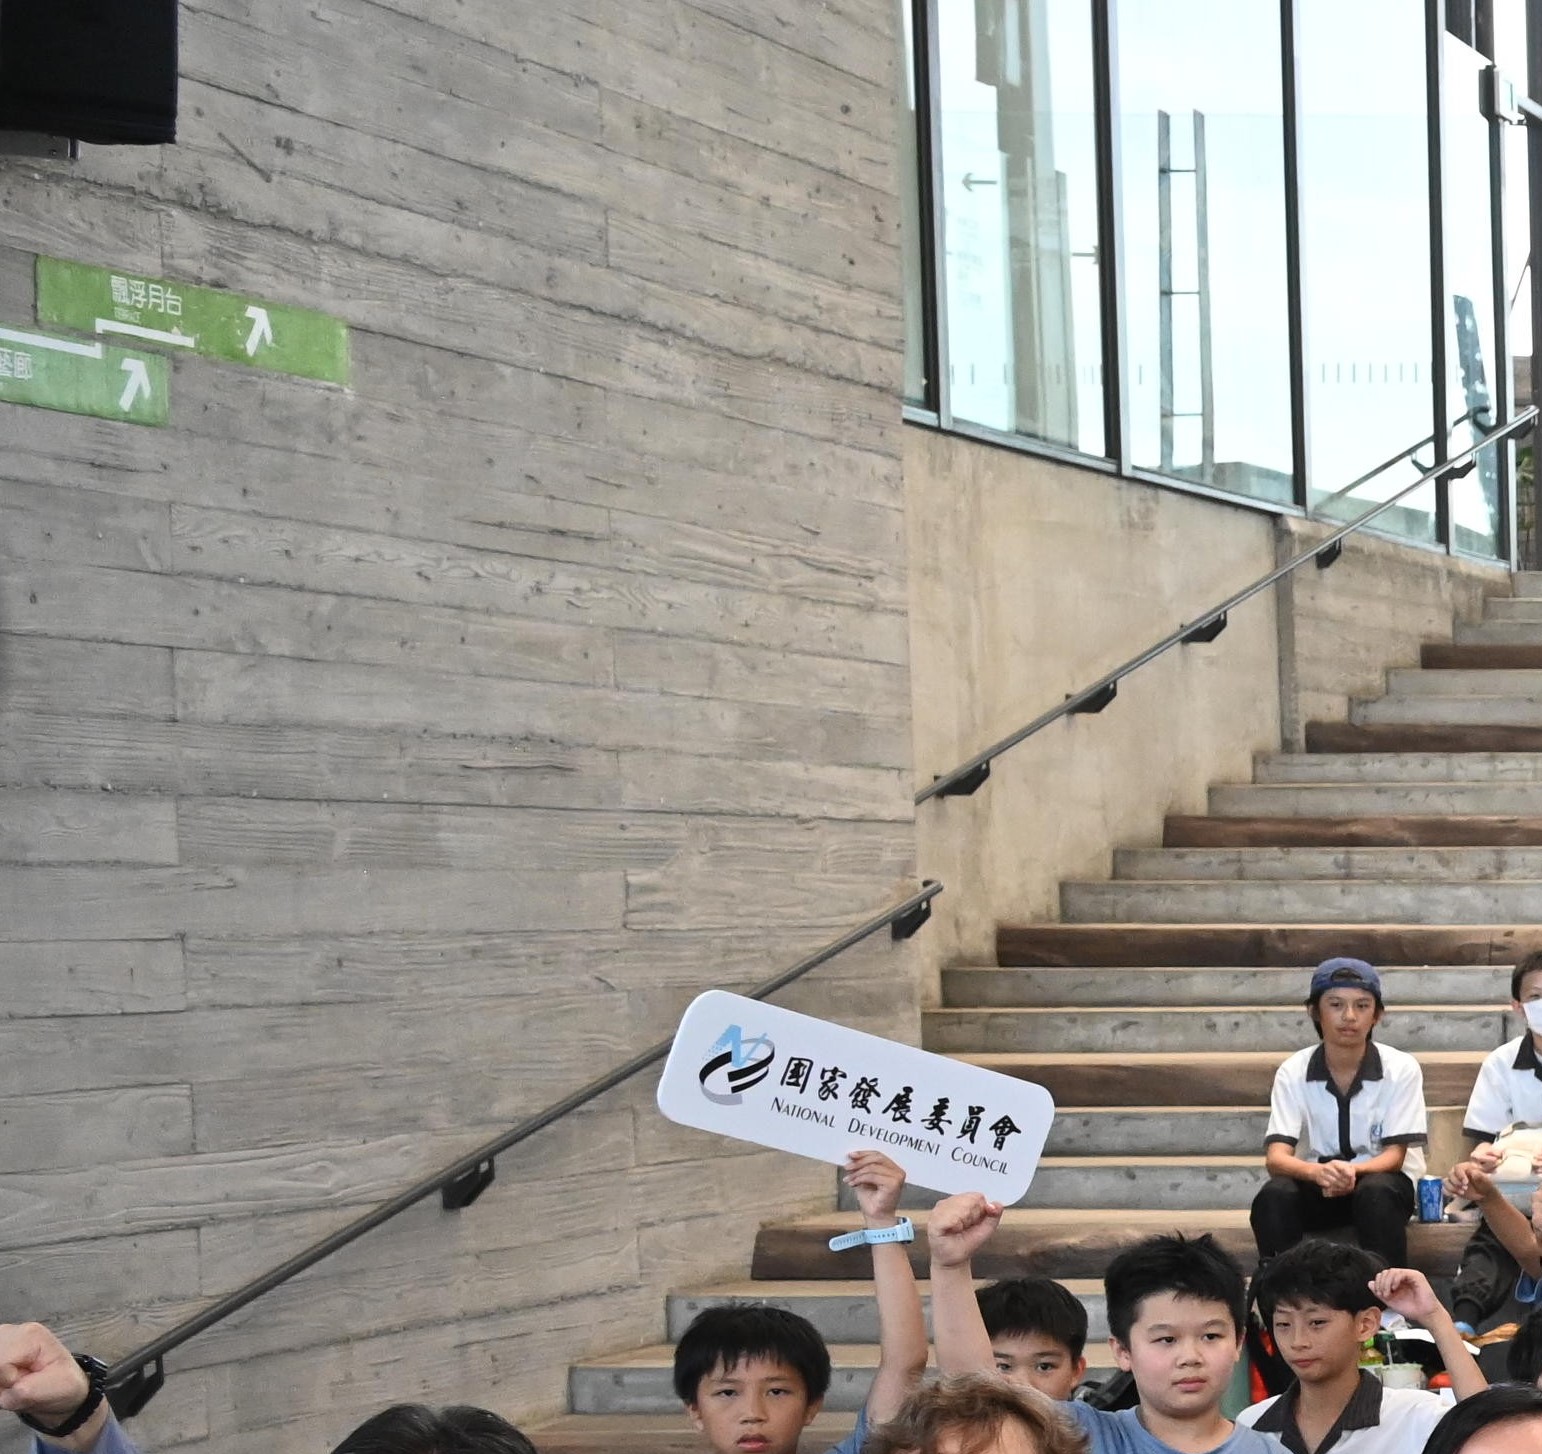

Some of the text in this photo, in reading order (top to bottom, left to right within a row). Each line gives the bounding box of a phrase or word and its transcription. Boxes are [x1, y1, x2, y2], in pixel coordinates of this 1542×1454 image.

[779, 1056, 1022, 1151] 國家發展委員會
